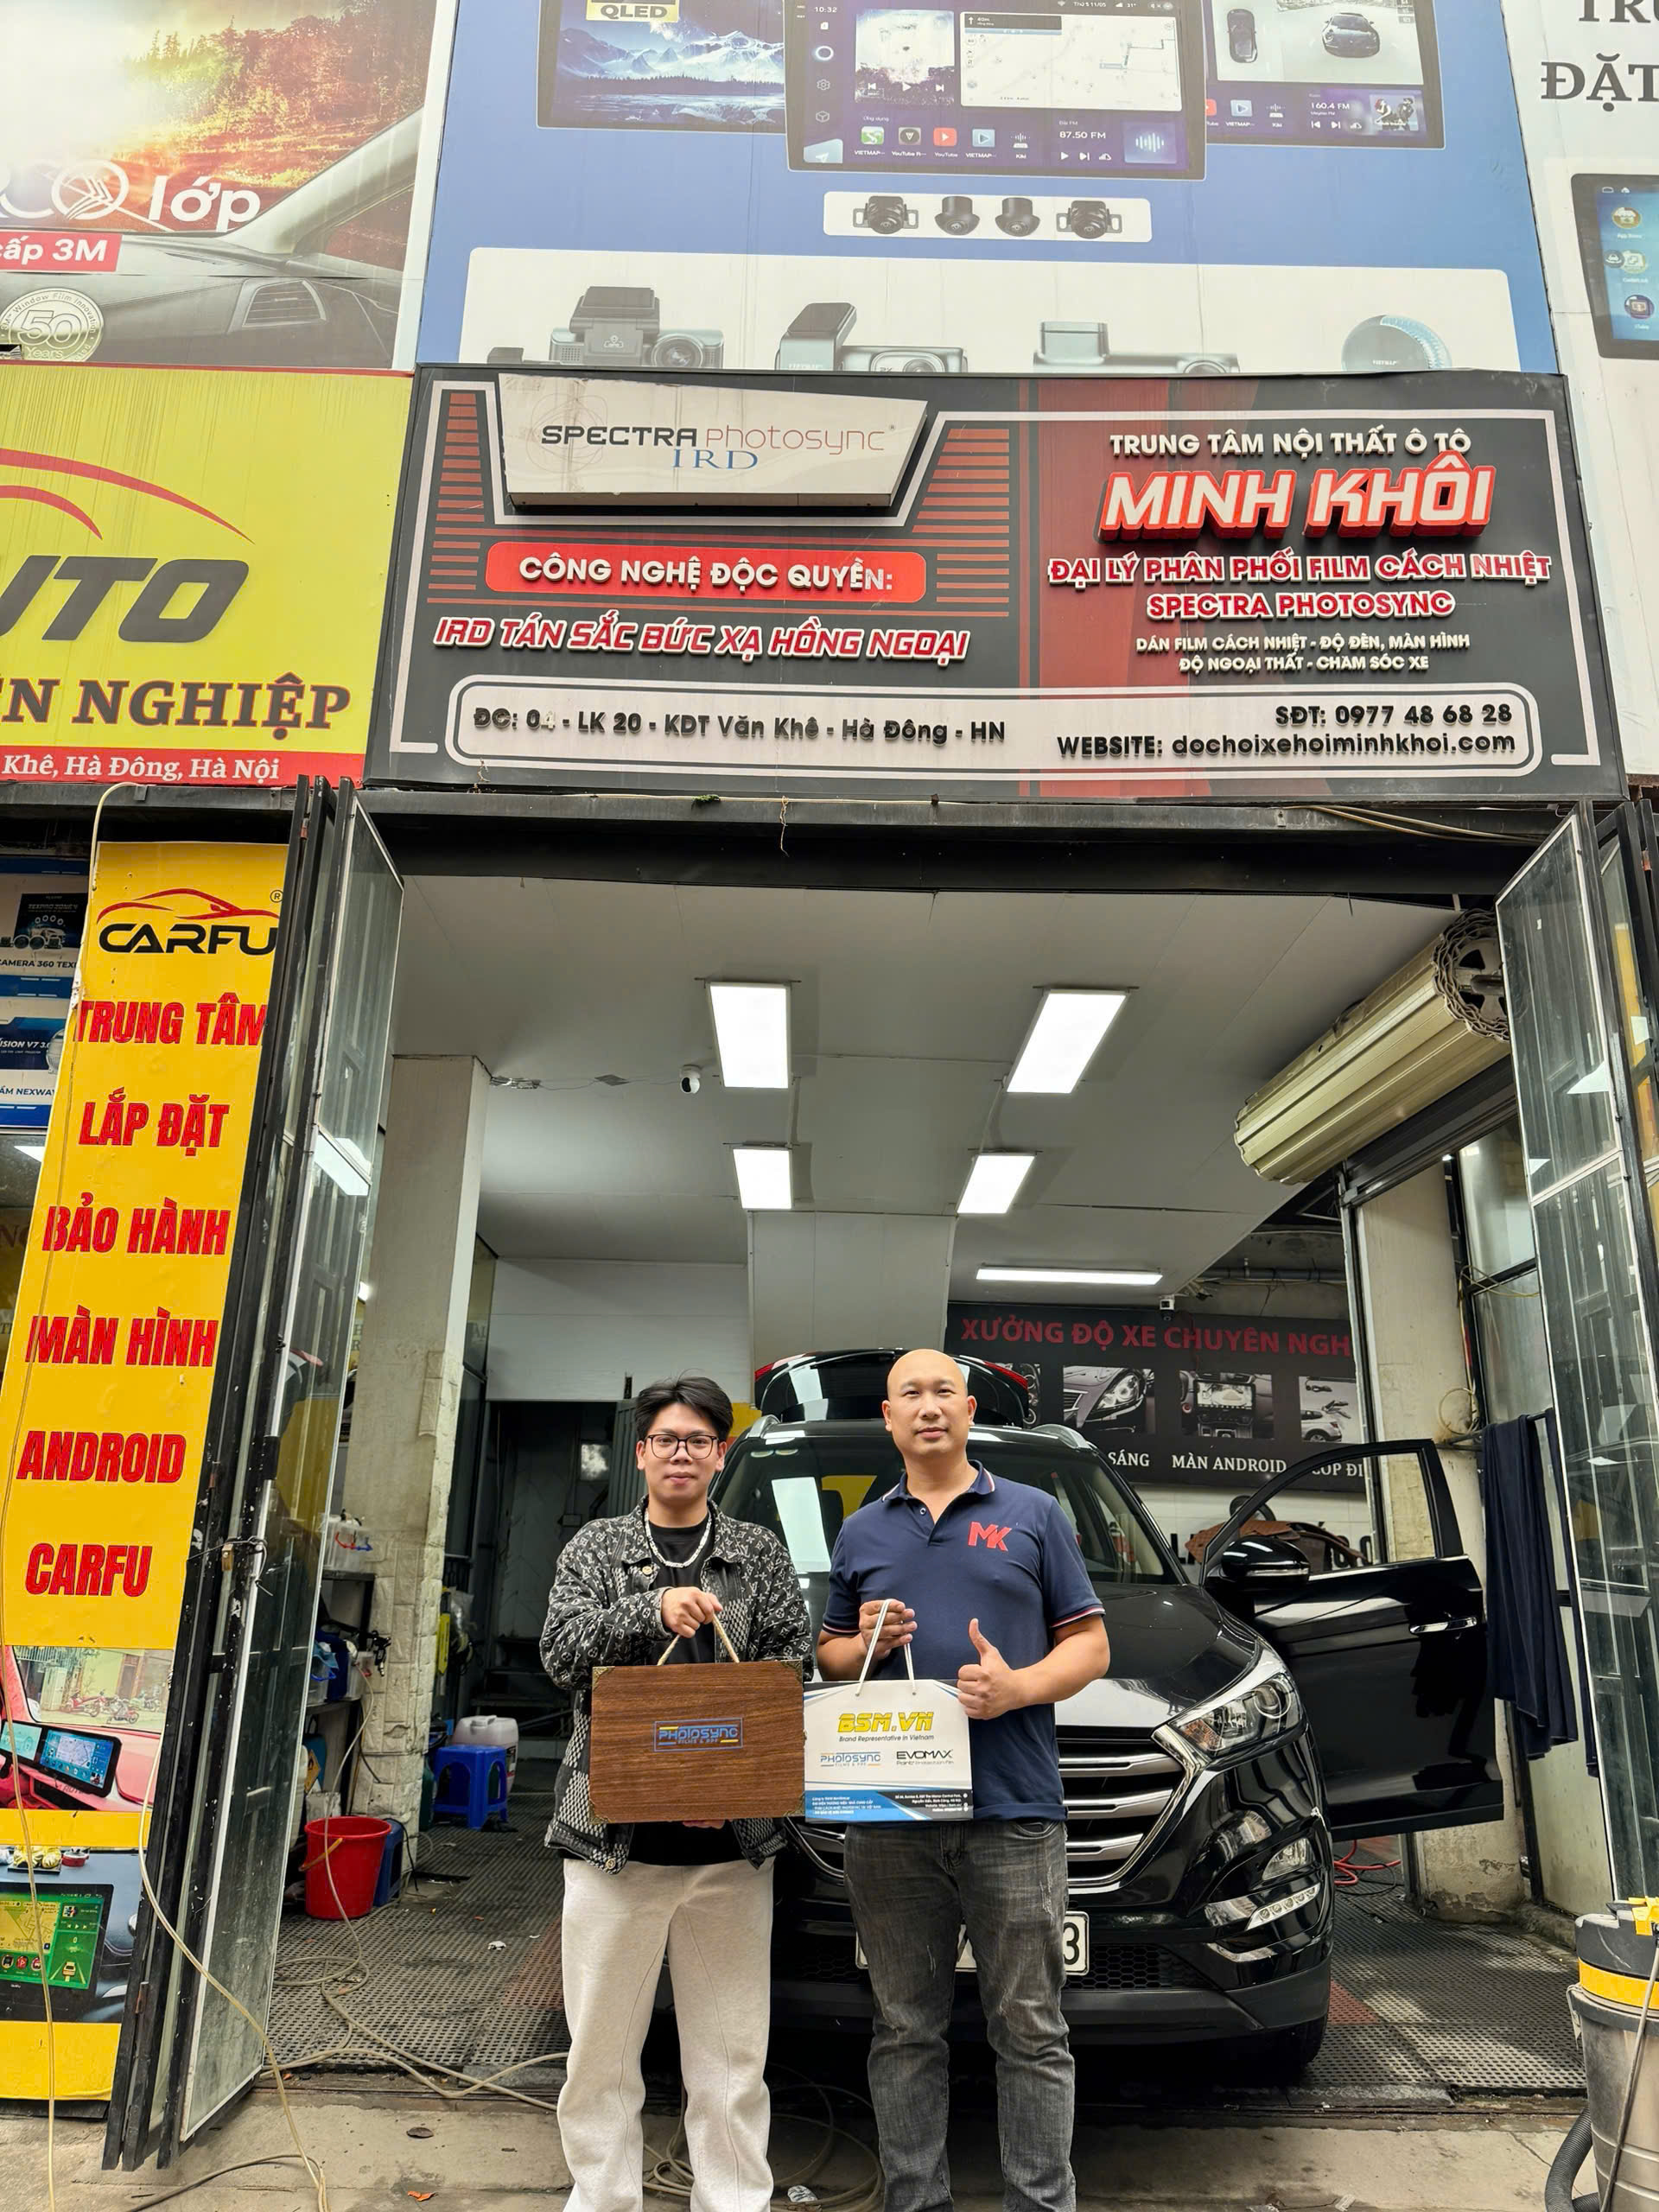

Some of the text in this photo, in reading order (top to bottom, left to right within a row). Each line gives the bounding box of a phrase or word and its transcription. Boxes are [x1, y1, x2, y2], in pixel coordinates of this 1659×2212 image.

[601, 4, 668, 20] QLED
[1541, 53, 1659, 111] ĐẶT
[149, 175, 261, 232] lớp
[52, 238, 108, 262] 3M
[13, 292, 97, 334] Window Film Innovation
[18, 309, 83, 350] 50
[26, 346, 64, 359] Years
[541, 425, 697, 447] SPECTRA
[1110, 424, 1471, 460] TRUNG TÂM NỘI THẤT Ô TÔ
[671, 448, 760, 470] IRD
[1099, 450, 1497, 539] MINH KHÔI
[519, 552, 893, 594] CÔNG NGHỆ ĐỘC QUYỀN:
[1048, 546, 1552, 590] ĐẠI LÝ PHÂN PHỐI FILM CÁCH NHIỆT
[1147, 590, 1456, 619] SPECTRA PHOTOSYNC
[433, 609, 971, 667] IRD TÁN SẮC BỨC XẠ HỒNG NGOẠI
[1136, 635, 1170, 651] DÁN
[1174, 637, 1207, 650] FILM
[1211, 634, 1260, 651] CÁCH
[1263, 633, 1307, 652] NHIỆT
[1319, 633, 1345, 652] ĐỘ
[1348, 633, 1385, 652] ĐÈN,
[1389, 632, 1426, 649] MÀN
[1429, 632, 1471, 648] HÌNH
[1179, 655, 1205, 674] ĐỘ
[1207, 657, 1262, 674] NGOẠI
[1264, 651, 1304, 671] THẤT
[1369, 653, 1405, 671] SÓC
[1408, 657, 1429, 671] XE
[71, 671, 352, 741] NGHIỆP
[1275, 703, 1513, 726] SĐT: 0977 48 68 28
[578, 711, 606, 731] LK
[613, 713, 642, 733] 20
[717, 715, 765, 737] Văn
[774, 716, 820, 740] Khê
[842, 718, 874, 741] Hà
[883, 719, 948, 747] Đông
[970, 721, 1005, 741] HN
[1057, 733, 1516, 757] WEBSITE: dochoixehoiminhkhoi.com
[1, 753, 280, 784] Khê, Hà Đông, Hà Nội
[99, 922, 280, 957] CARFU
[73, 992, 268, 1046] TRUNG TÂM
[79, 1086, 230, 1156] LẮP ĐẶT
[41, 1192, 120, 1254] BẢO
[126, 1197, 231, 1255] HÀNH
[25, 1305, 219, 1367] MÀN HÌNH
[961, 1314, 1065, 1344] XƯỞNG
[1071, 1319, 1114, 1351] ĐỘ
[1122, 1325, 1156, 1347] XE
[1164, 1326, 1280, 1354] CHUYÊN
[16, 1430, 188, 1484] ANDROID
[1108, 1449, 1150, 1467] SÁNG
[1172, 1452, 1208, 1470] MÀN
[1213, 1457, 1287, 1473] ANDROID
[968, 1521, 1012, 1552] MK
[25, 1543, 153, 1597] CARFU
[837, 1711, 934, 1733] BSM.VN
[896, 1749, 954, 1760] EVOMAX
